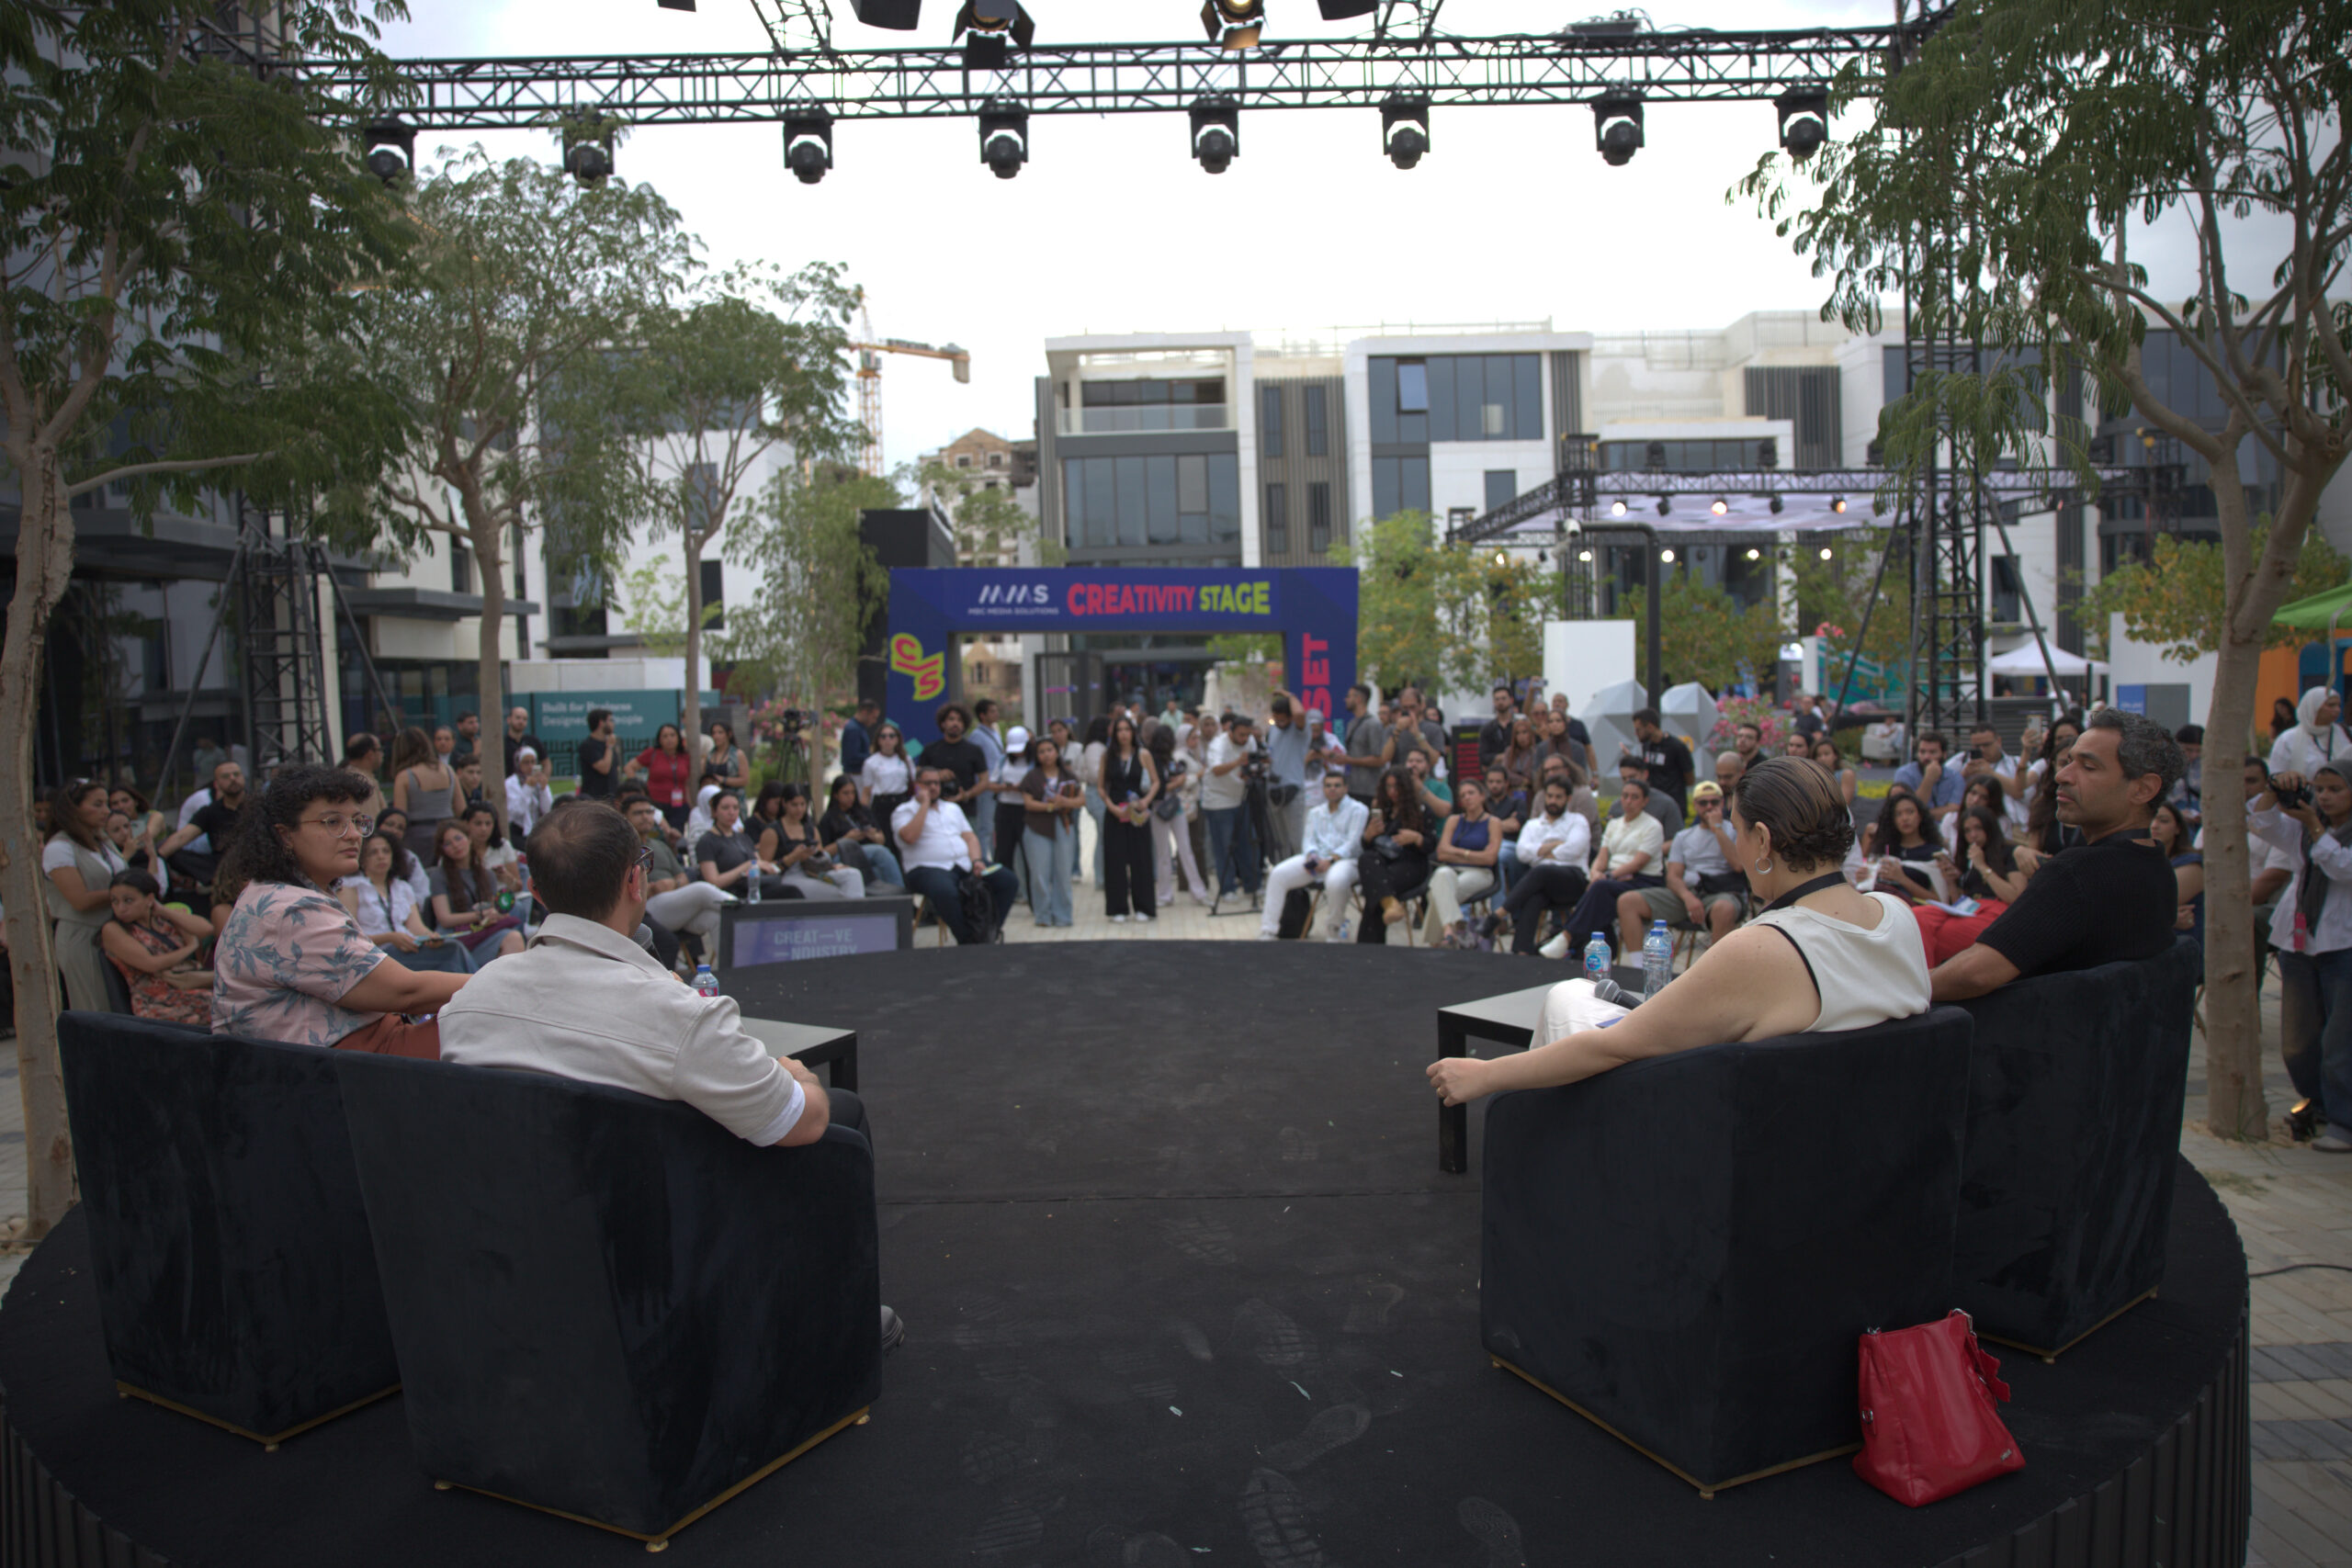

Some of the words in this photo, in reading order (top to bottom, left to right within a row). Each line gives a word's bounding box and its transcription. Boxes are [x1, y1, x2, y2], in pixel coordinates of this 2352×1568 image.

[1067, 583, 1195, 615] CREATIVITY
[1199, 581, 1271, 615] STAGE
[1302, 632, 1332, 733] SET
[542, 702, 566, 713] Built
[570, 701, 583, 711] for
